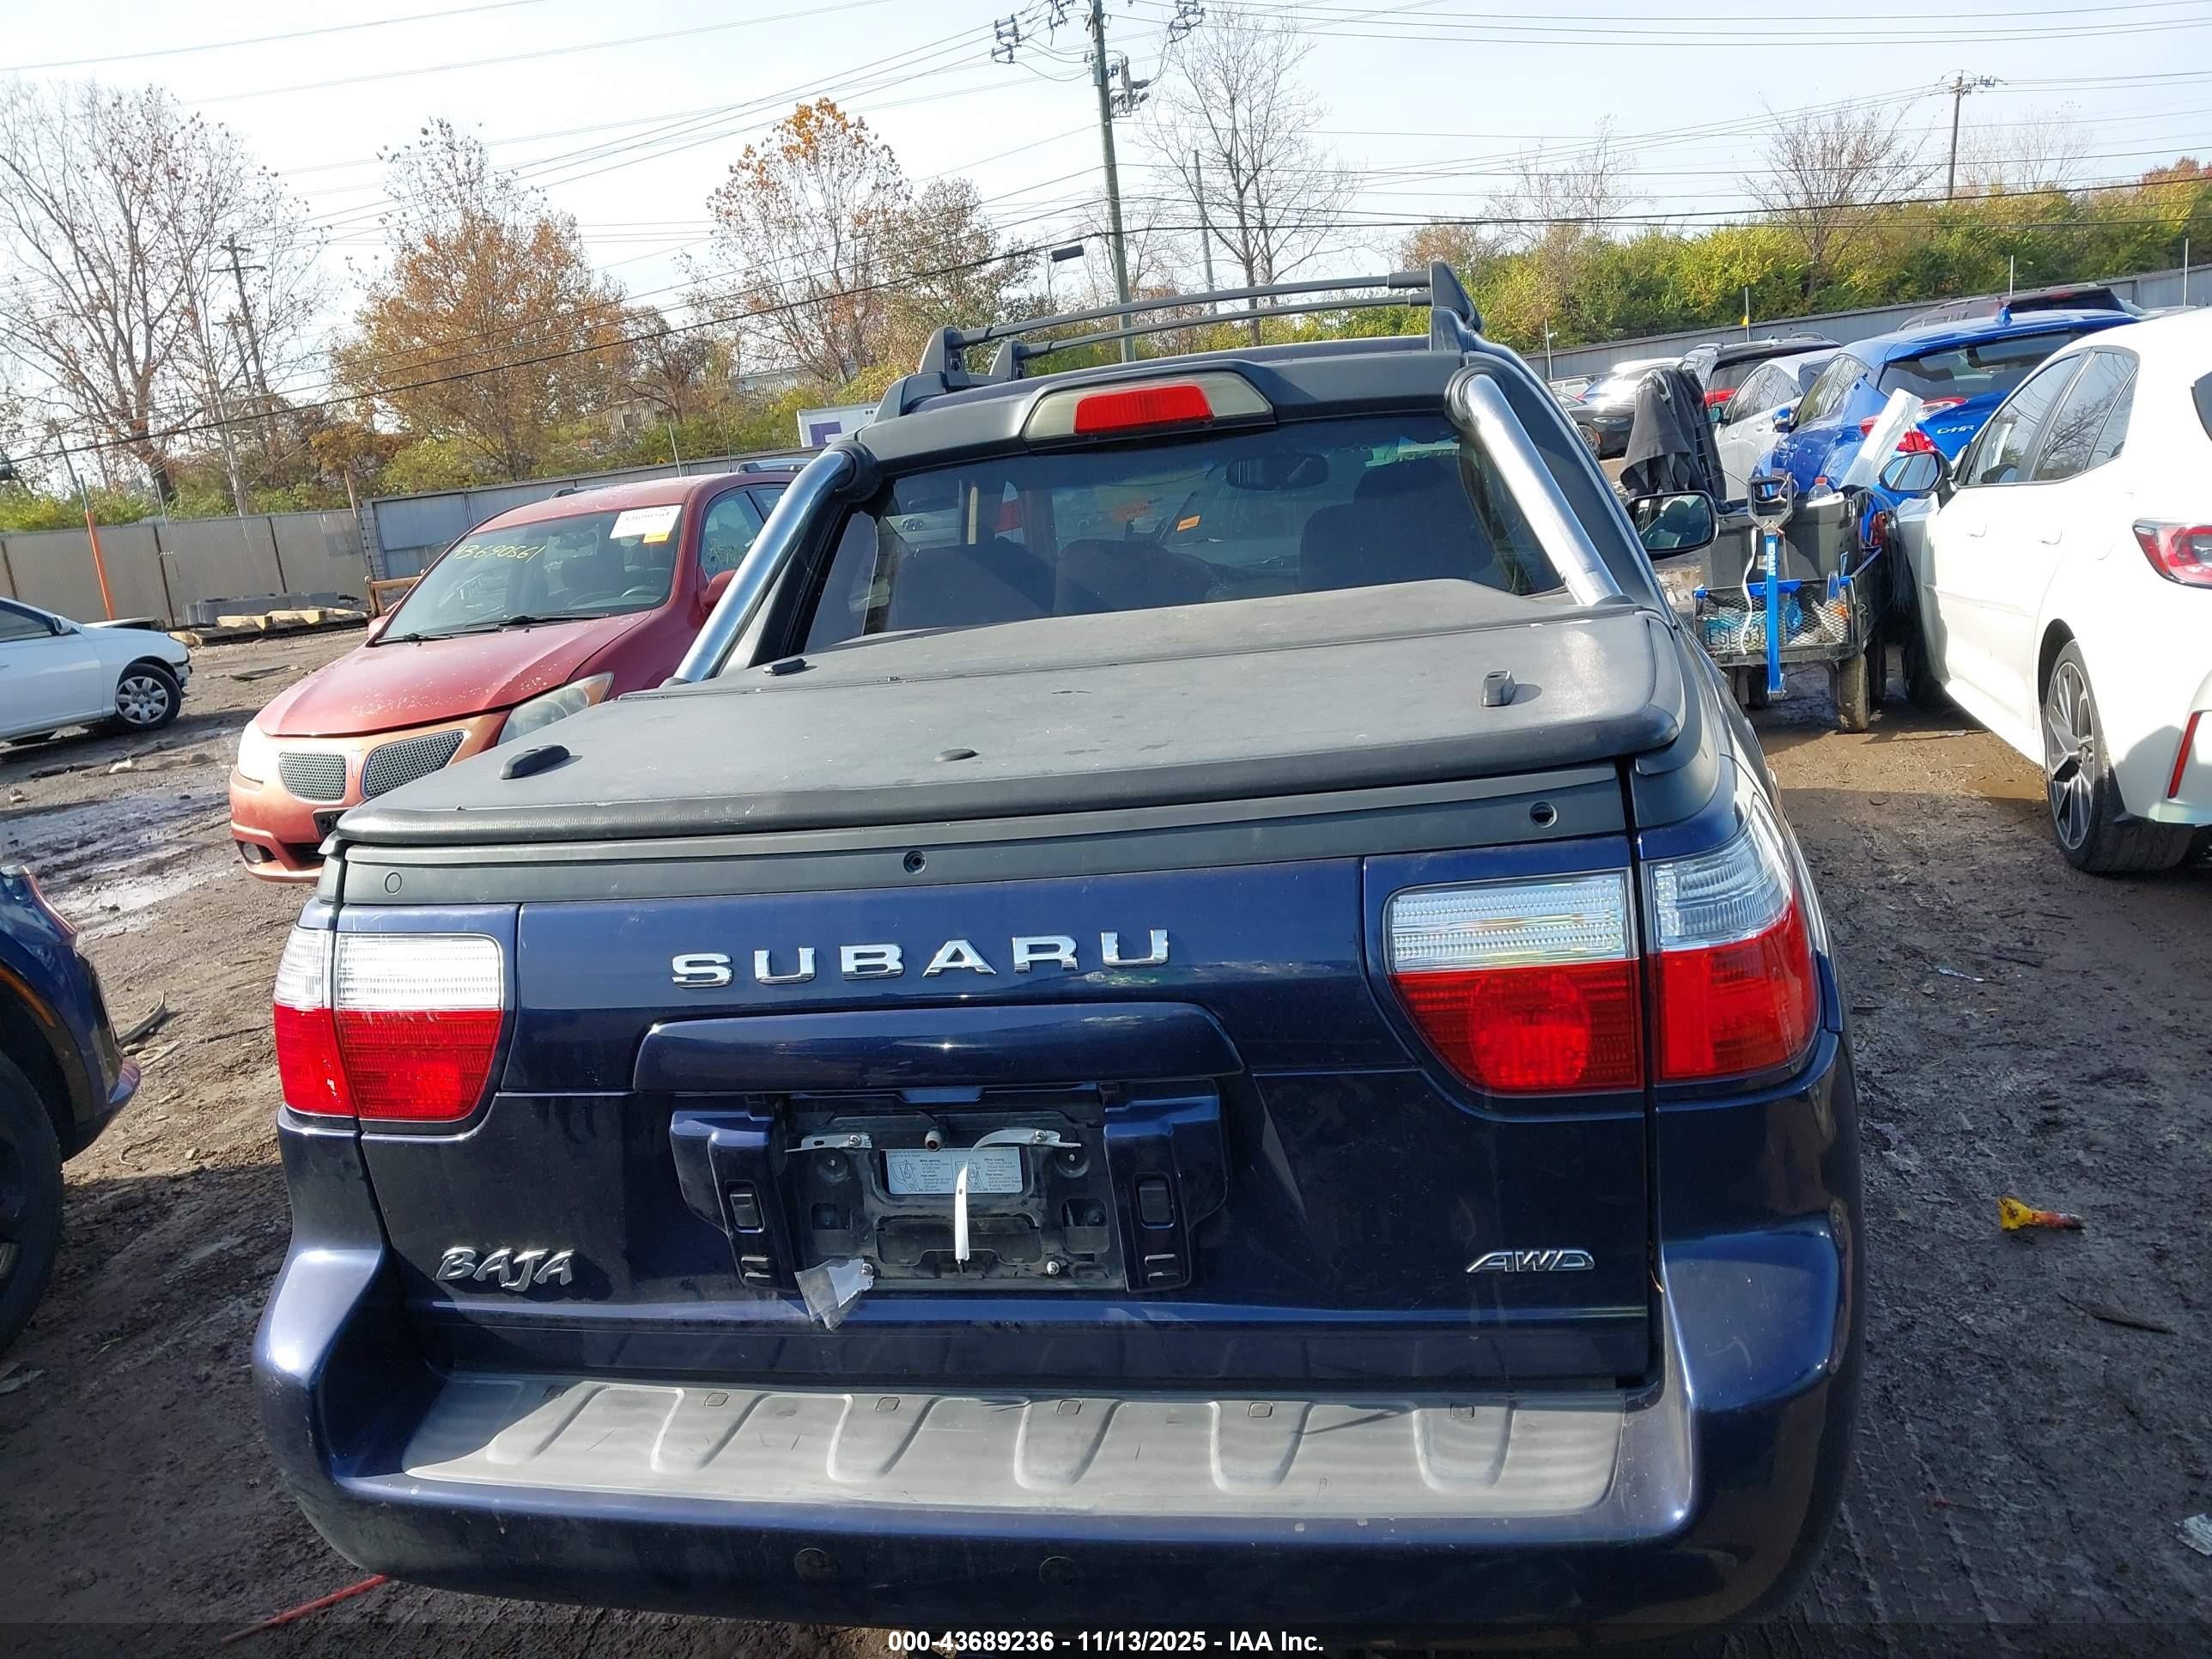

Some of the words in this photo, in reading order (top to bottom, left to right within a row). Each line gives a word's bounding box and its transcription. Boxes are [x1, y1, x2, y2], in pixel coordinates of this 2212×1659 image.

[1767, 542, 1777, 577] KOBALT
[672, 928, 1169, 988] SUBARU
[435, 1246, 574, 1292] BAJA
[1465, 1249, 1595, 1273] AWD
